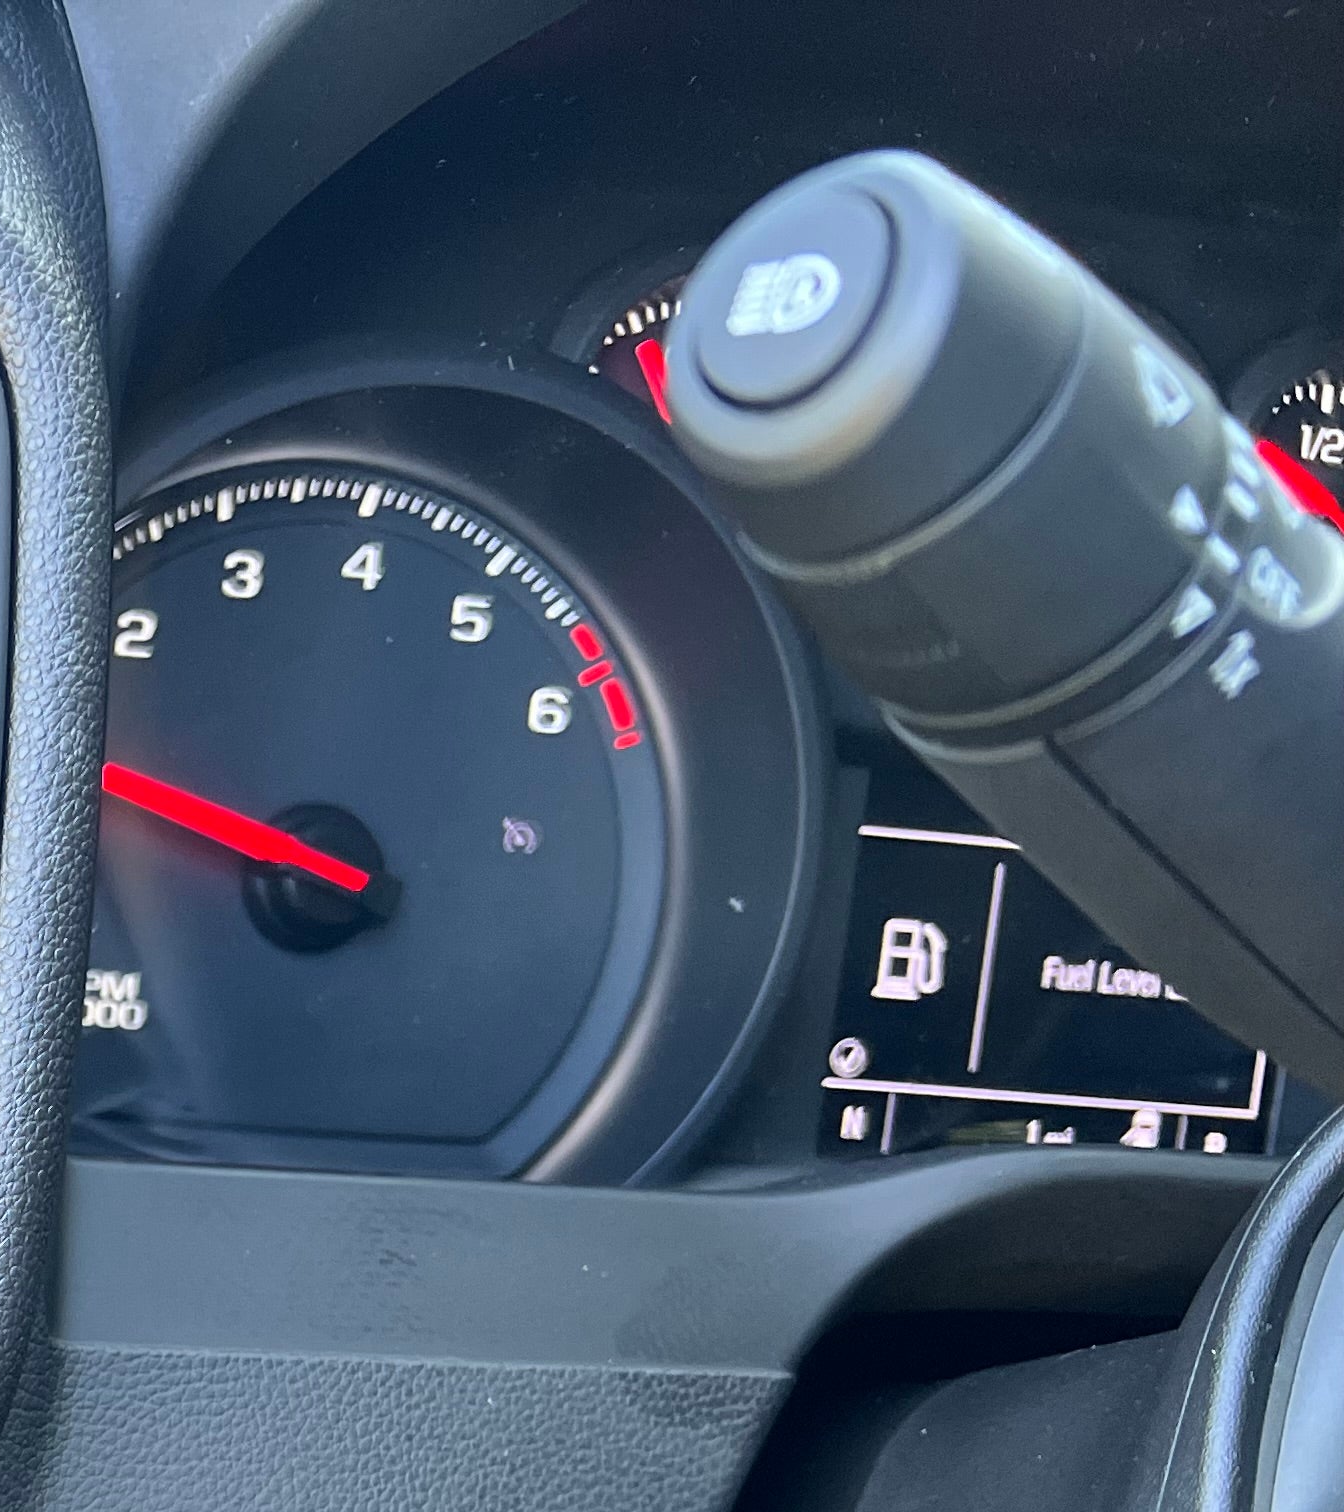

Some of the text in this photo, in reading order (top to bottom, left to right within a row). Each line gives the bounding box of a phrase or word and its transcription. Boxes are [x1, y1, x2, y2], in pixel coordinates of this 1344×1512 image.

[1300, 423, 1344, 465] 1/2
[221, 549, 265, 600] 3
[341, 541, 384, 591] 4
[113, 608, 158, 659] 2
[449, 593, 495, 643] 5
[527, 686, 573, 735] 6
[85, 969, 142, 1002] PM
